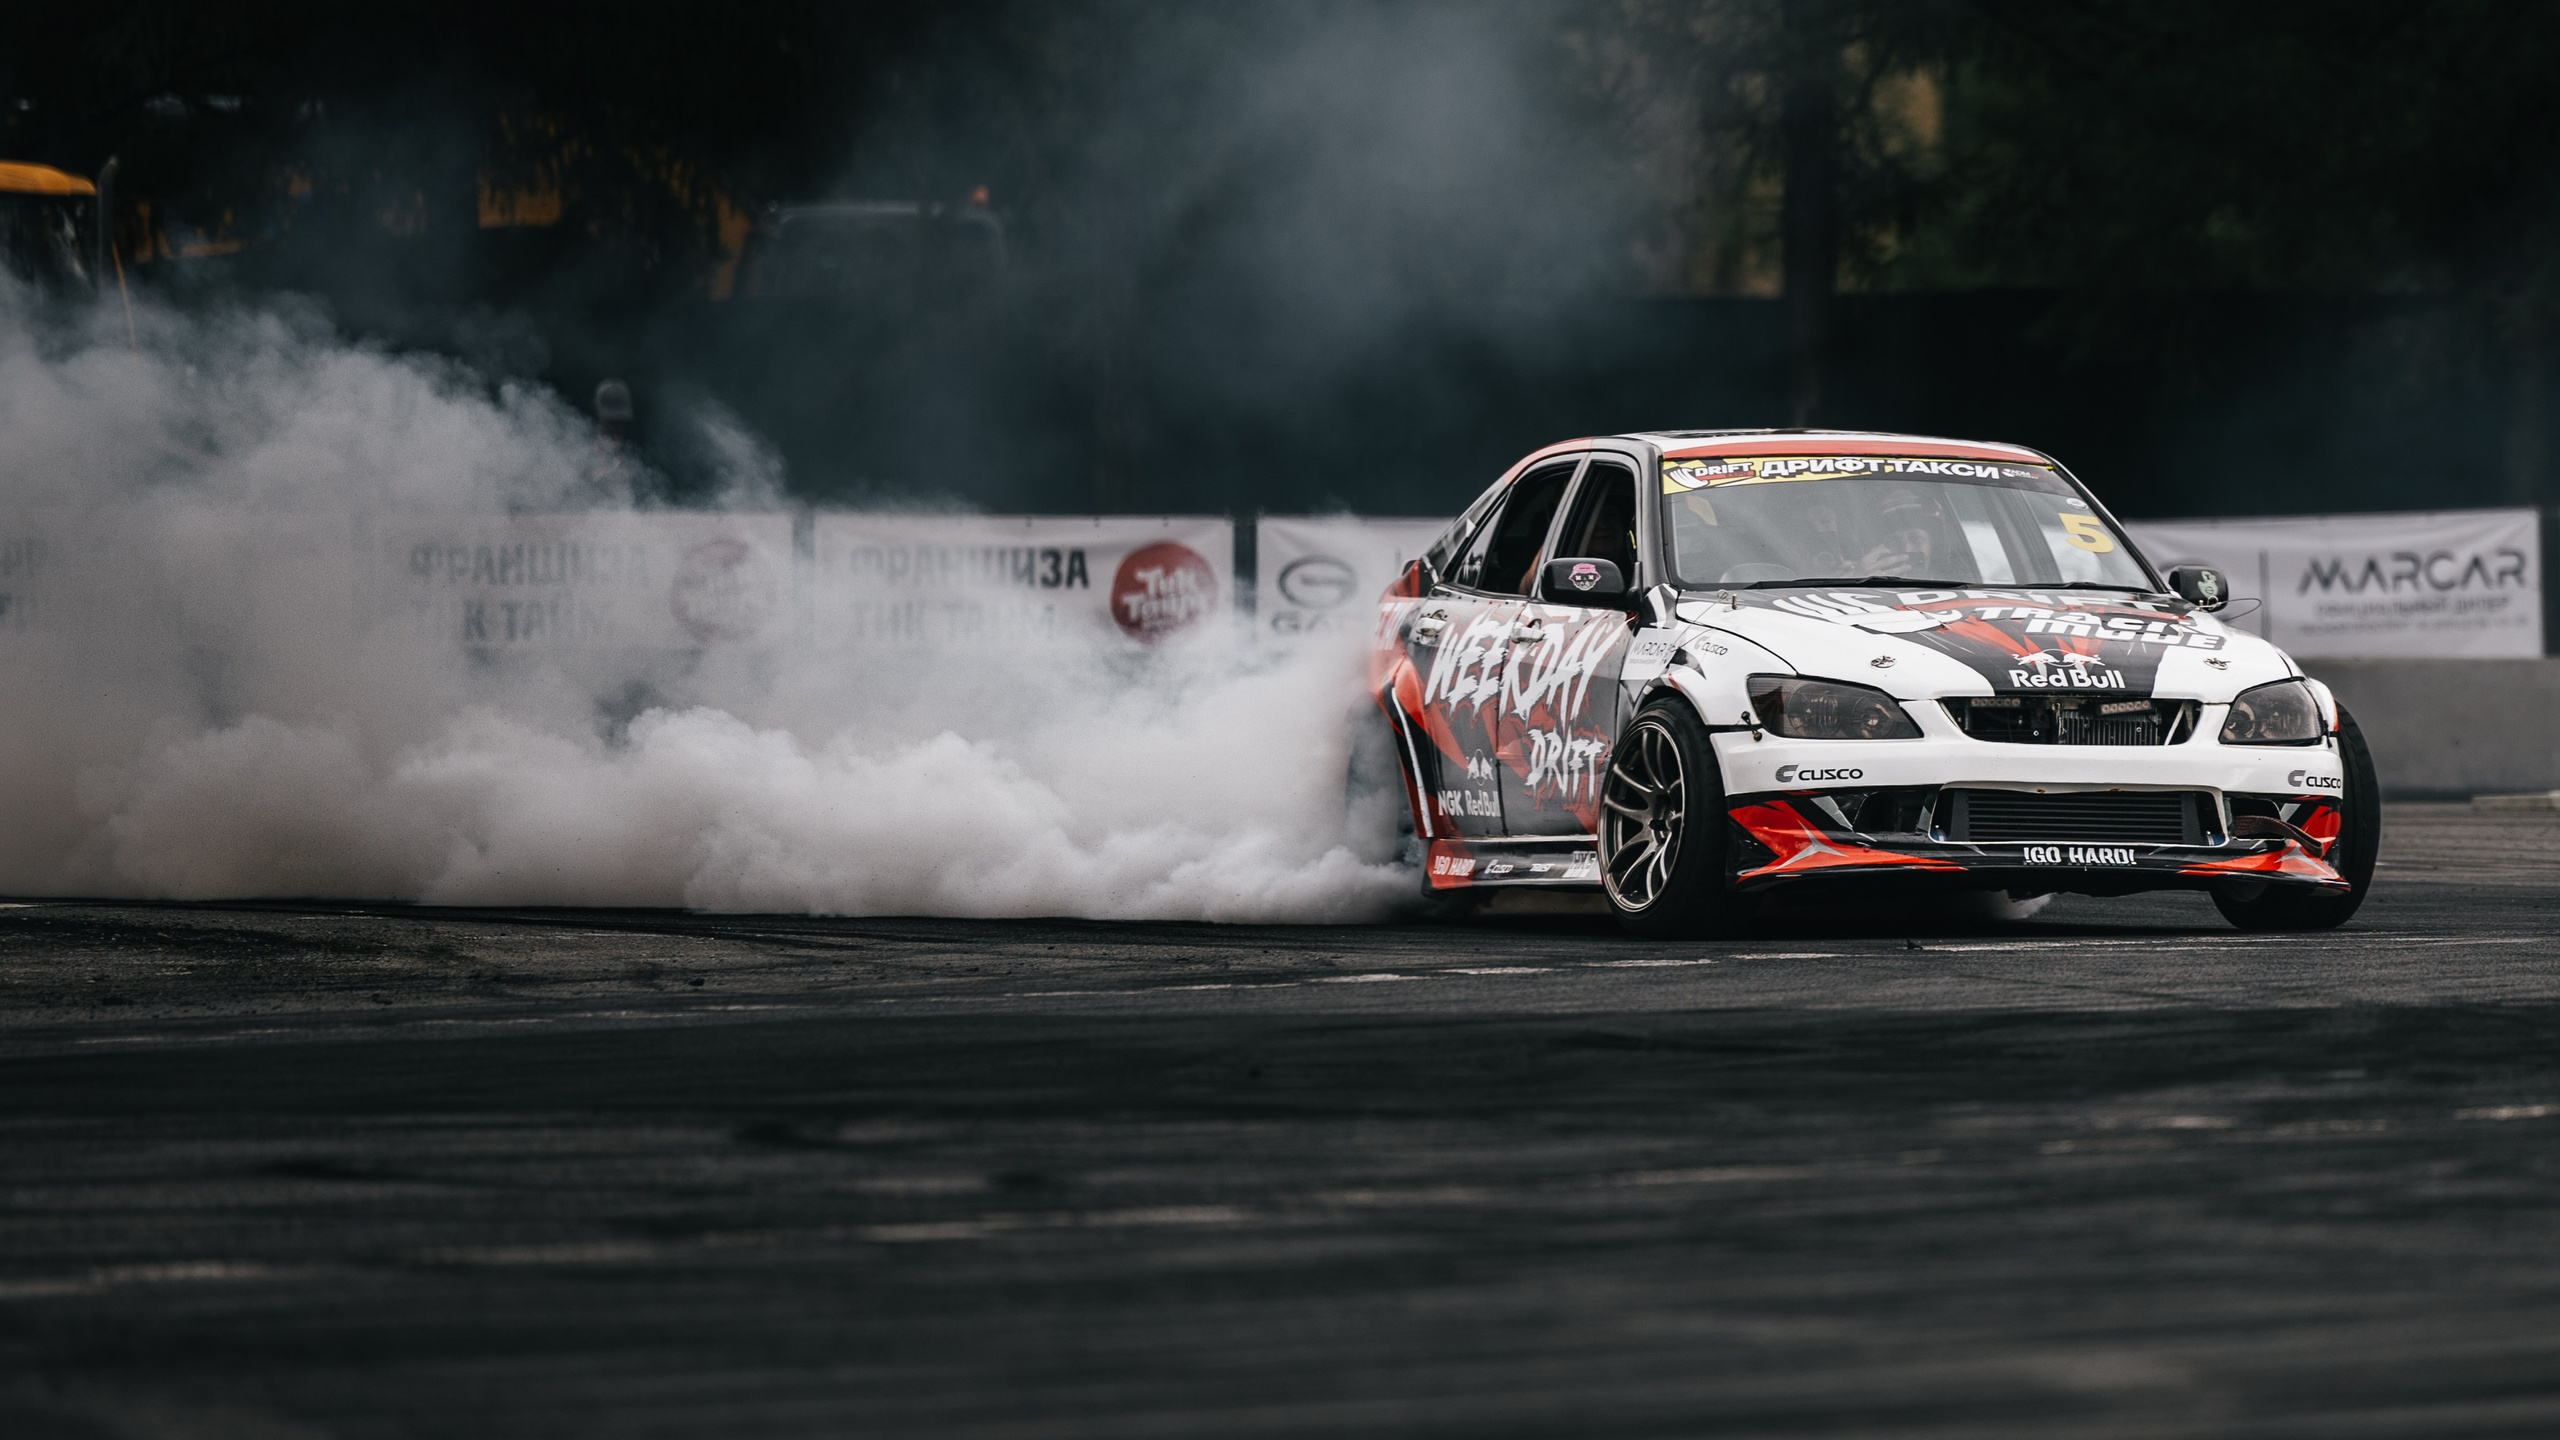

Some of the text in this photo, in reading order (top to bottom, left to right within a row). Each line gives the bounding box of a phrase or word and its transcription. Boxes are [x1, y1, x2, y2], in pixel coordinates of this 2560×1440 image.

[1694, 463, 1753, 477] DRIFT
[1760, 458, 1885, 478] ДРИФТ
[1886, 460, 1999, 480] ТАКСИ
[2057, 512, 2114, 553] 5
[2300, 547, 2528, 595] MARCAR
[1425, 612, 1628, 727] WEEKDAY
[2009, 669, 2126, 689] Red Bull
[1525, 725, 1605, 801] DRIFT
[1798, 768, 1864, 781] CUSCO
[1437, 790, 1465, 817] NGK
[2023, 846, 2137, 865] !GO HARD!
